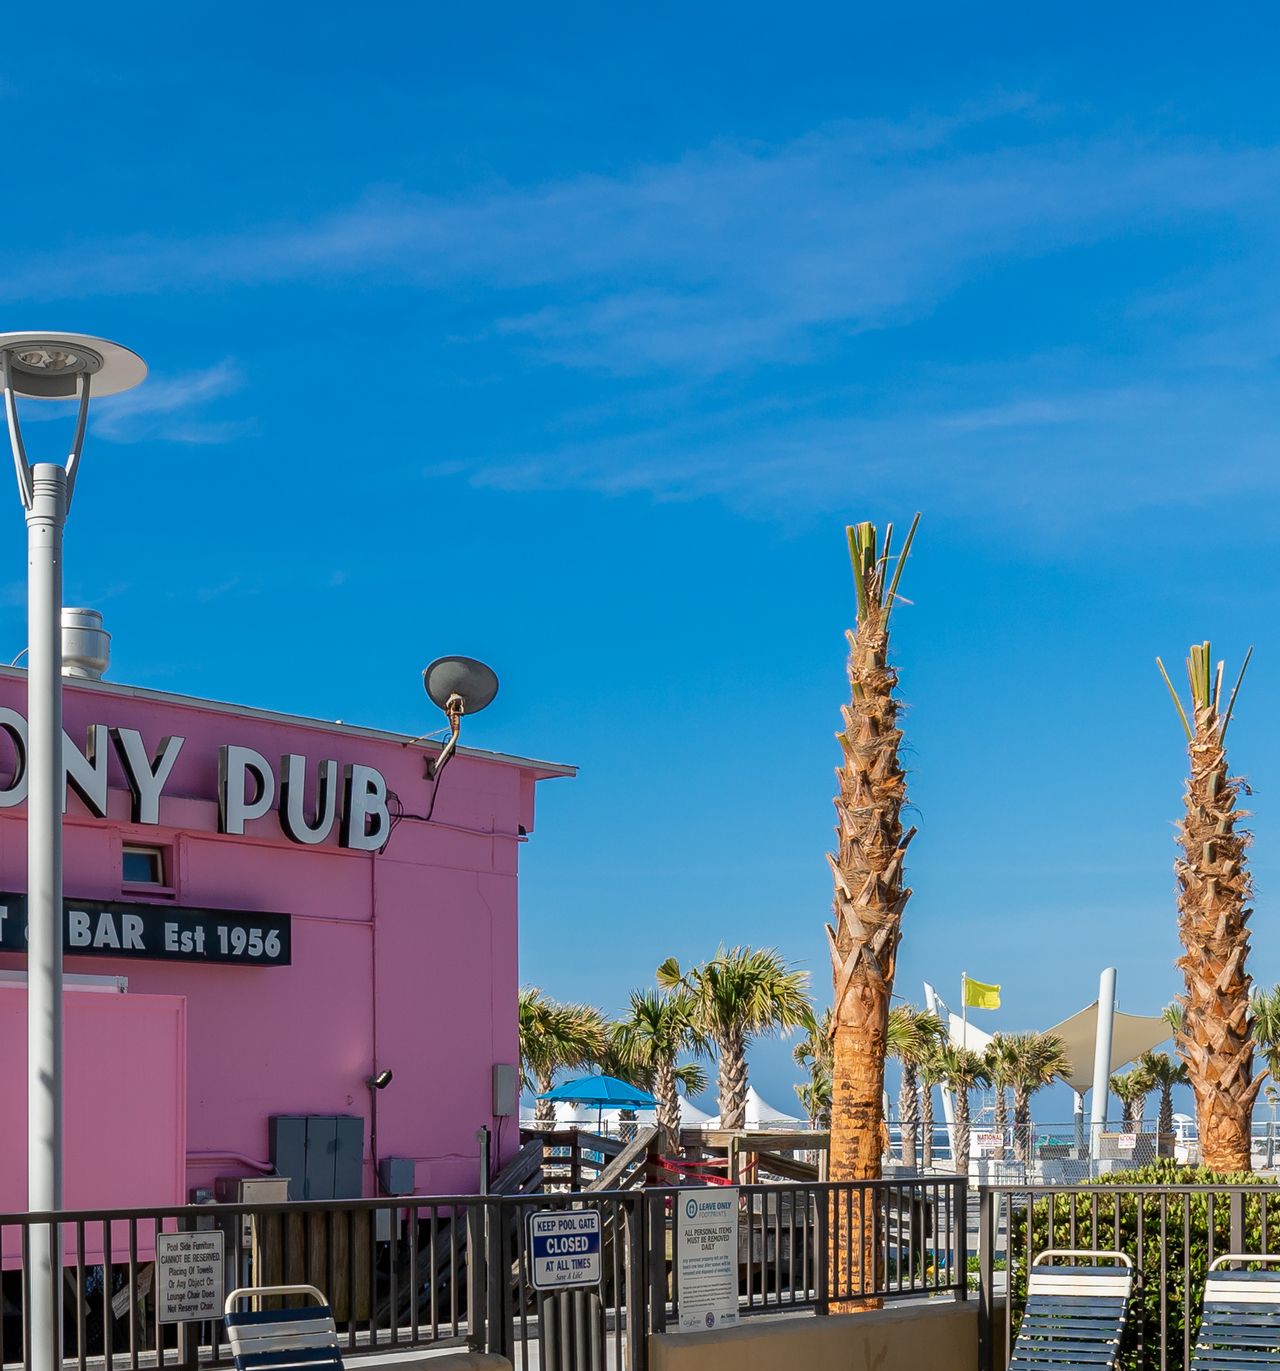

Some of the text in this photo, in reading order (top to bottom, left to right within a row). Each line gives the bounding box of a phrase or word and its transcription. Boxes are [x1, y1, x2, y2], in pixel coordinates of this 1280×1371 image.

[217, 744, 391, 852] PUB
[69, 911, 145, 950] BAR
[164, 922, 206, 953] Est
[217, 926, 281, 958] 1956
[699, 1201, 732, 1211] LEAVE ONLY
[537, 1218, 595, 1232] KEEP POOL GATE
[684, 1229, 694, 1237] ALL
[167, 1240, 215, 1252] Pool Side Furniture
[546, 1236, 589, 1254] CLOSED
[161, 1254, 183, 1265] CANNOT
[184, 1253, 192, 1263] BE
[545, 1258, 591, 1272] AT ALL TIMES
[168, 1265, 214, 1277] Placing Of Towels
[168, 1277, 214, 1289] Or Any Object On
[167, 1289, 216, 1302] Lounge Chair Does
[167, 1304, 177, 1313] Not
[177, 1303, 199, 1312] Reserve
